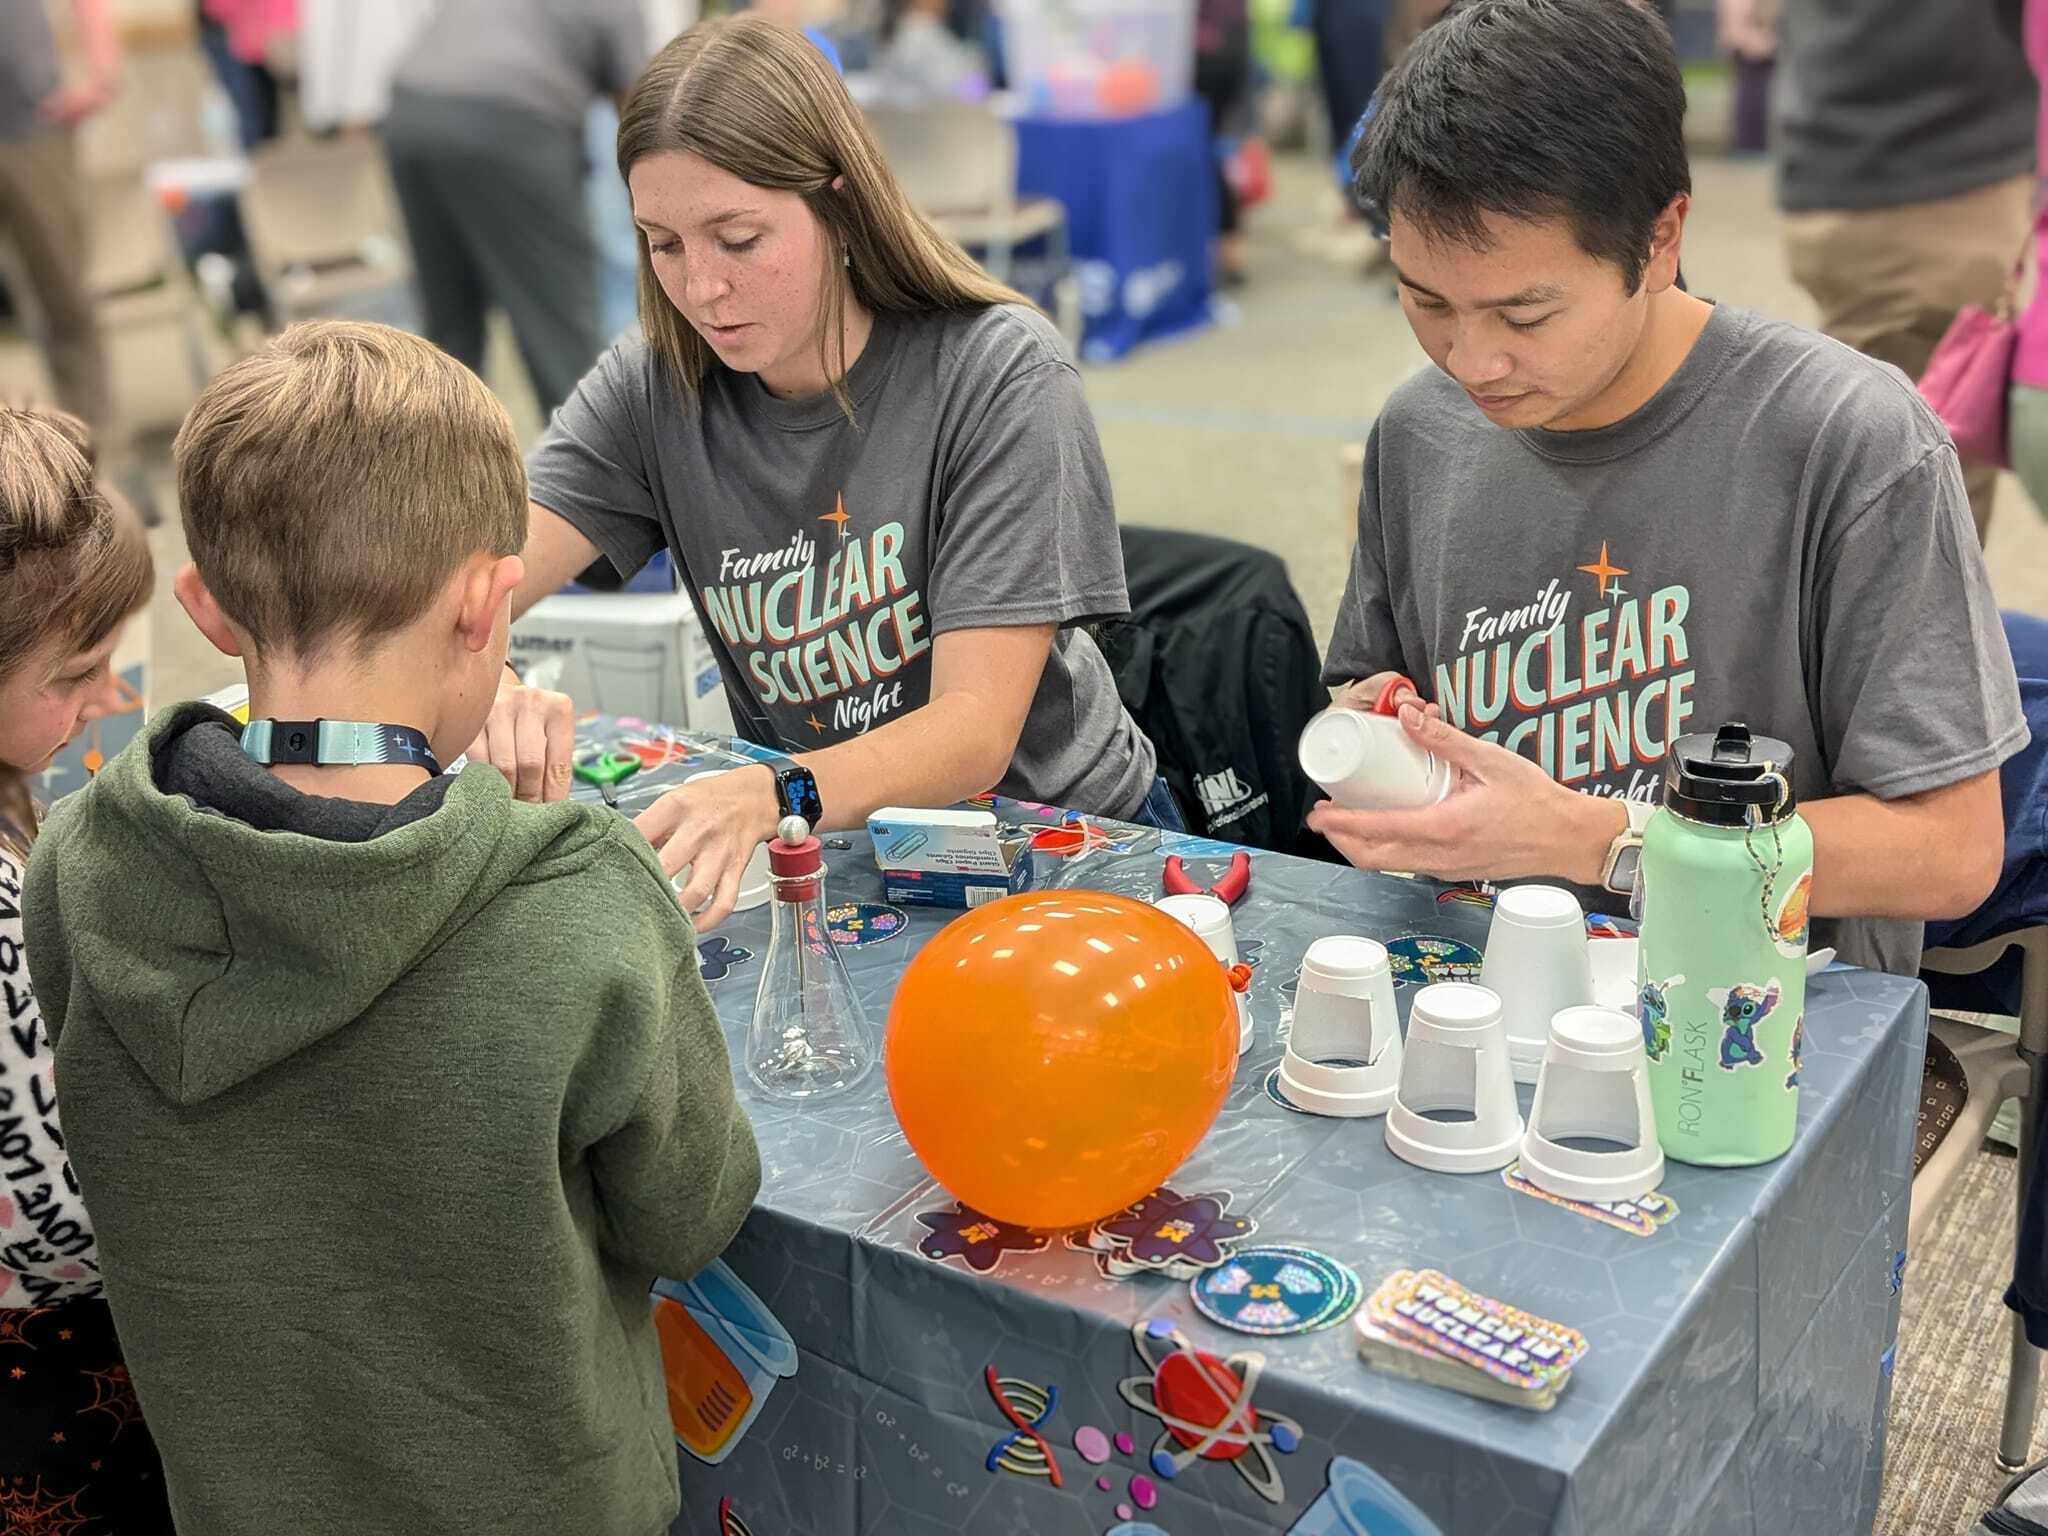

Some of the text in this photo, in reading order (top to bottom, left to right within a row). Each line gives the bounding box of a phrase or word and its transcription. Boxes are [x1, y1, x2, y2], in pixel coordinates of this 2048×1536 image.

[702, 521, 908, 646] NUCLEAR
[720, 529, 816, 582] Family
[748, 590, 931, 706] SCIENCE
[1435, 584, 1690, 730] NUCLEAR
[1459, 578, 1571, 651] Family
[833, 681, 903, 735] Night
[1476, 670, 1695, 786] CIENCE
[13, 1183, 95, 1257] LOVE
